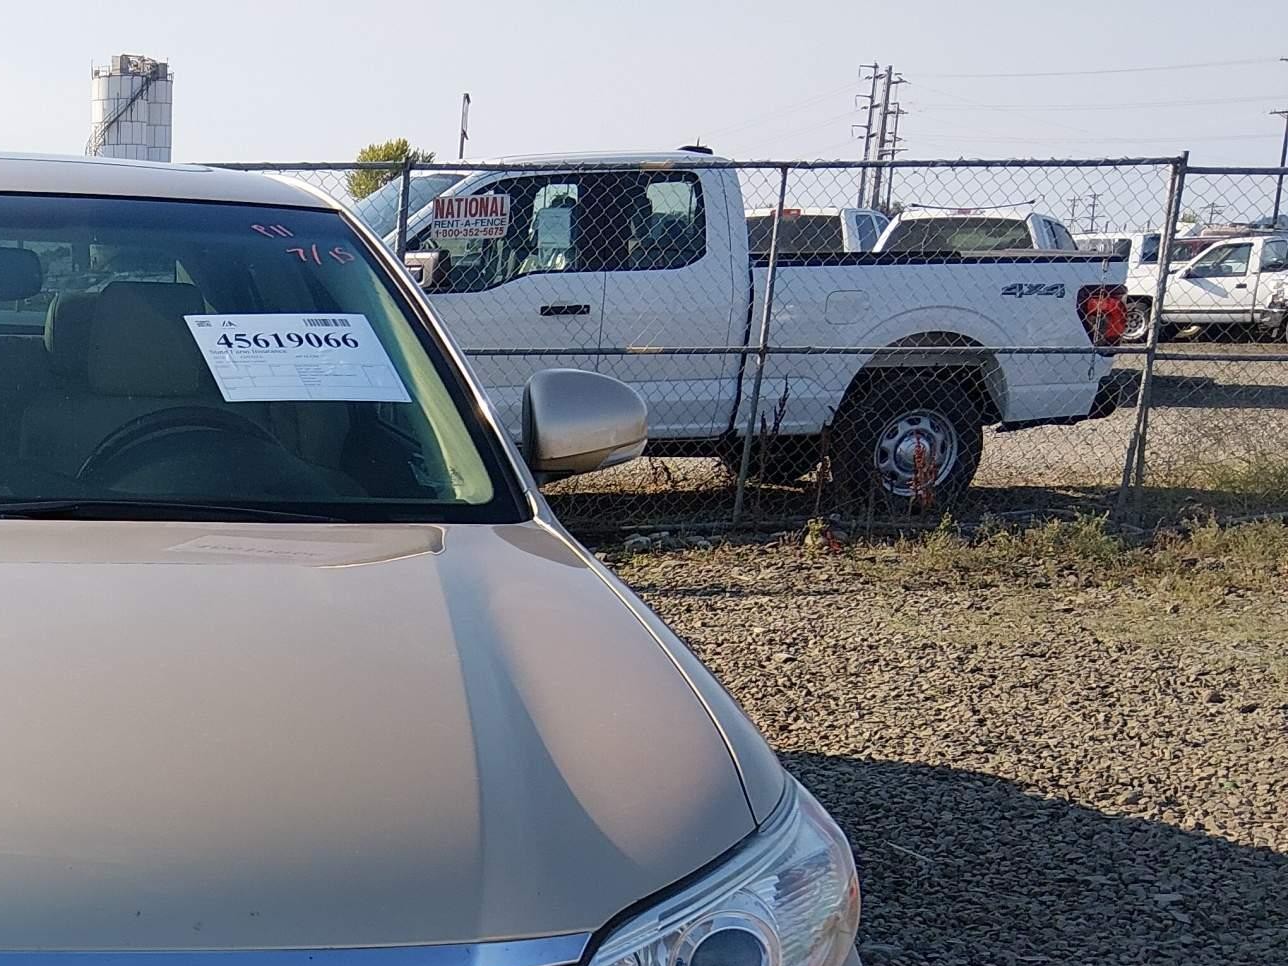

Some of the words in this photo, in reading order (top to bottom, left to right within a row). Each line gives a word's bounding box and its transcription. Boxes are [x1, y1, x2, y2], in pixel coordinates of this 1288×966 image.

[434, 196, 507, 219] NATIONAL
[433, 217, 507, 229] RENT-A-FENCE
[216, 332, 359, 349] 45619066
